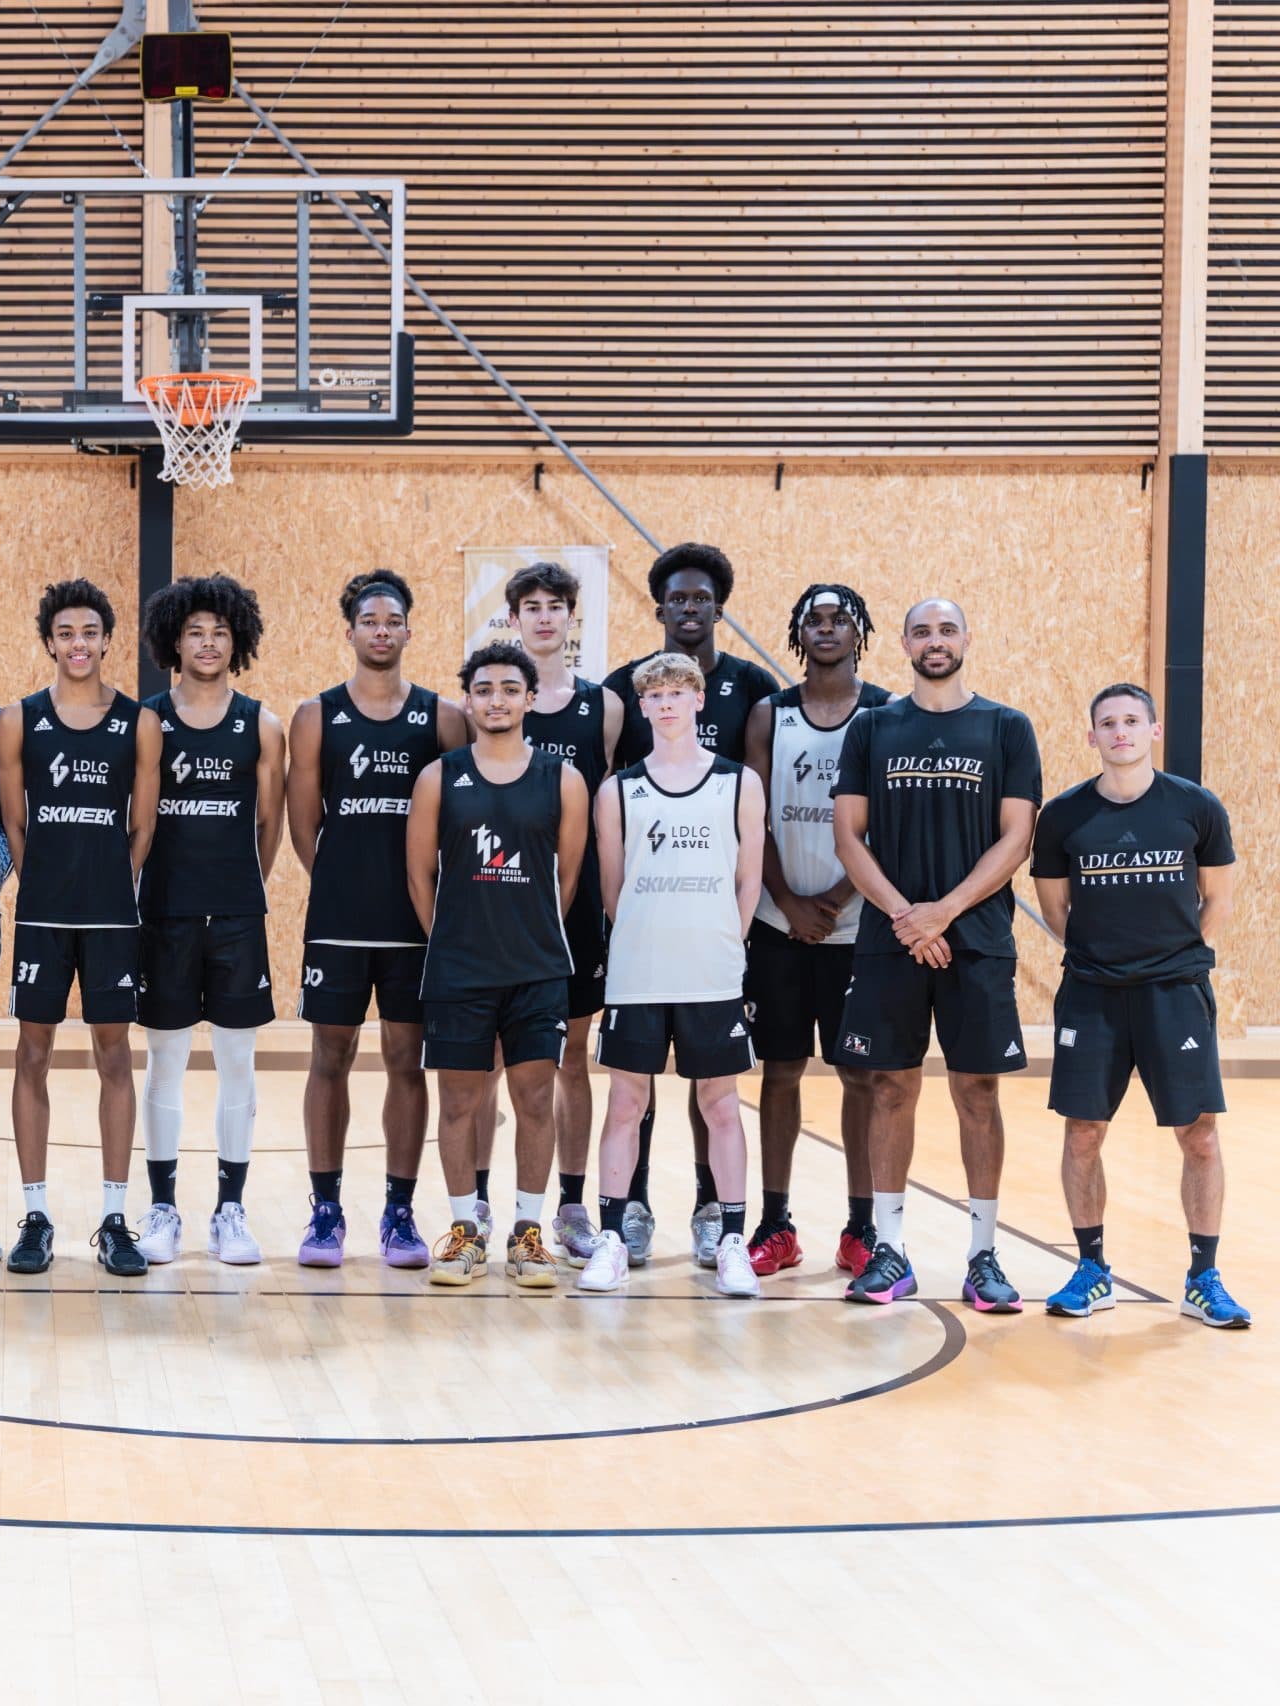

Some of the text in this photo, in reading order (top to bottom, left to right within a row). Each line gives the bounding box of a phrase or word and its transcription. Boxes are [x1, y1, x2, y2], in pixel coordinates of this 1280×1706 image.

[719, 681, 733, 696] 5
[578, 701, 590, 717] 5
[407, 711, 428, 725] 00
[107, 718, 128, 735] 31
[232, 719, 246, 734] 3
[196, 757, 234, 770] LDLC
[373, 750, 410, 764] LDLC
[73, 759, 110, 774] LDLC
[374, 764, 410, 774] ASVEL
[886, 756, 984, 776] LDLC ASVEL
[73, 774, 108, 785] ASVEL
[196, 770, 231, 781] ASVEL
[888, 778, 980, 793] BASKETBALL
[158, 798, 241, 817] SKWEEK
[781, 805, 834, 824] SKWE
[37, 805, 117, 826] SKWEEK
[671, 826, 711, 838] LDLC
[671, 840, 710, 849] ASVEL
[1078, 850, 1185, 869] LDLC ASVEL
[501, 875, 531, 884] ACADEMY
[634, 875, 724, 895] SKWEEK
[1081, 872, 1185, 886] BASKETBALL
